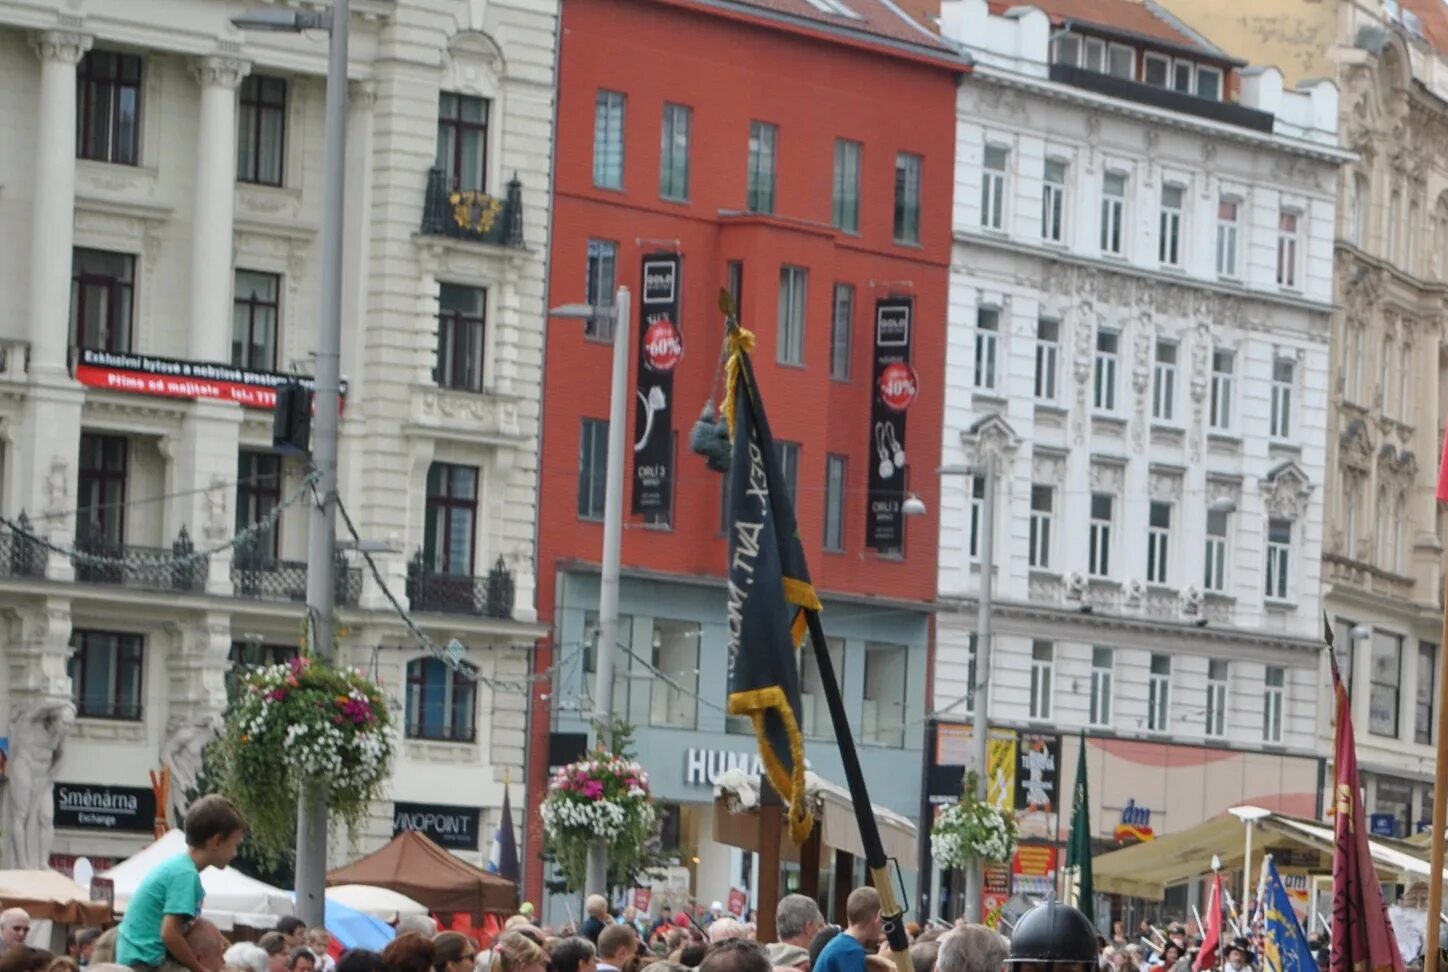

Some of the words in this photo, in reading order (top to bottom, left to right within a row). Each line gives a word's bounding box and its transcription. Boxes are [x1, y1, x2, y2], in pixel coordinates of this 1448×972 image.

[645, 337, 681, 357] -60%
[59, 787, 138, 810] Směnárna
[78, 812, 116, 827] Exchange
[392, 811, 472, 833] VINOPOINT
[1122, 798, 1150, 827] dm
